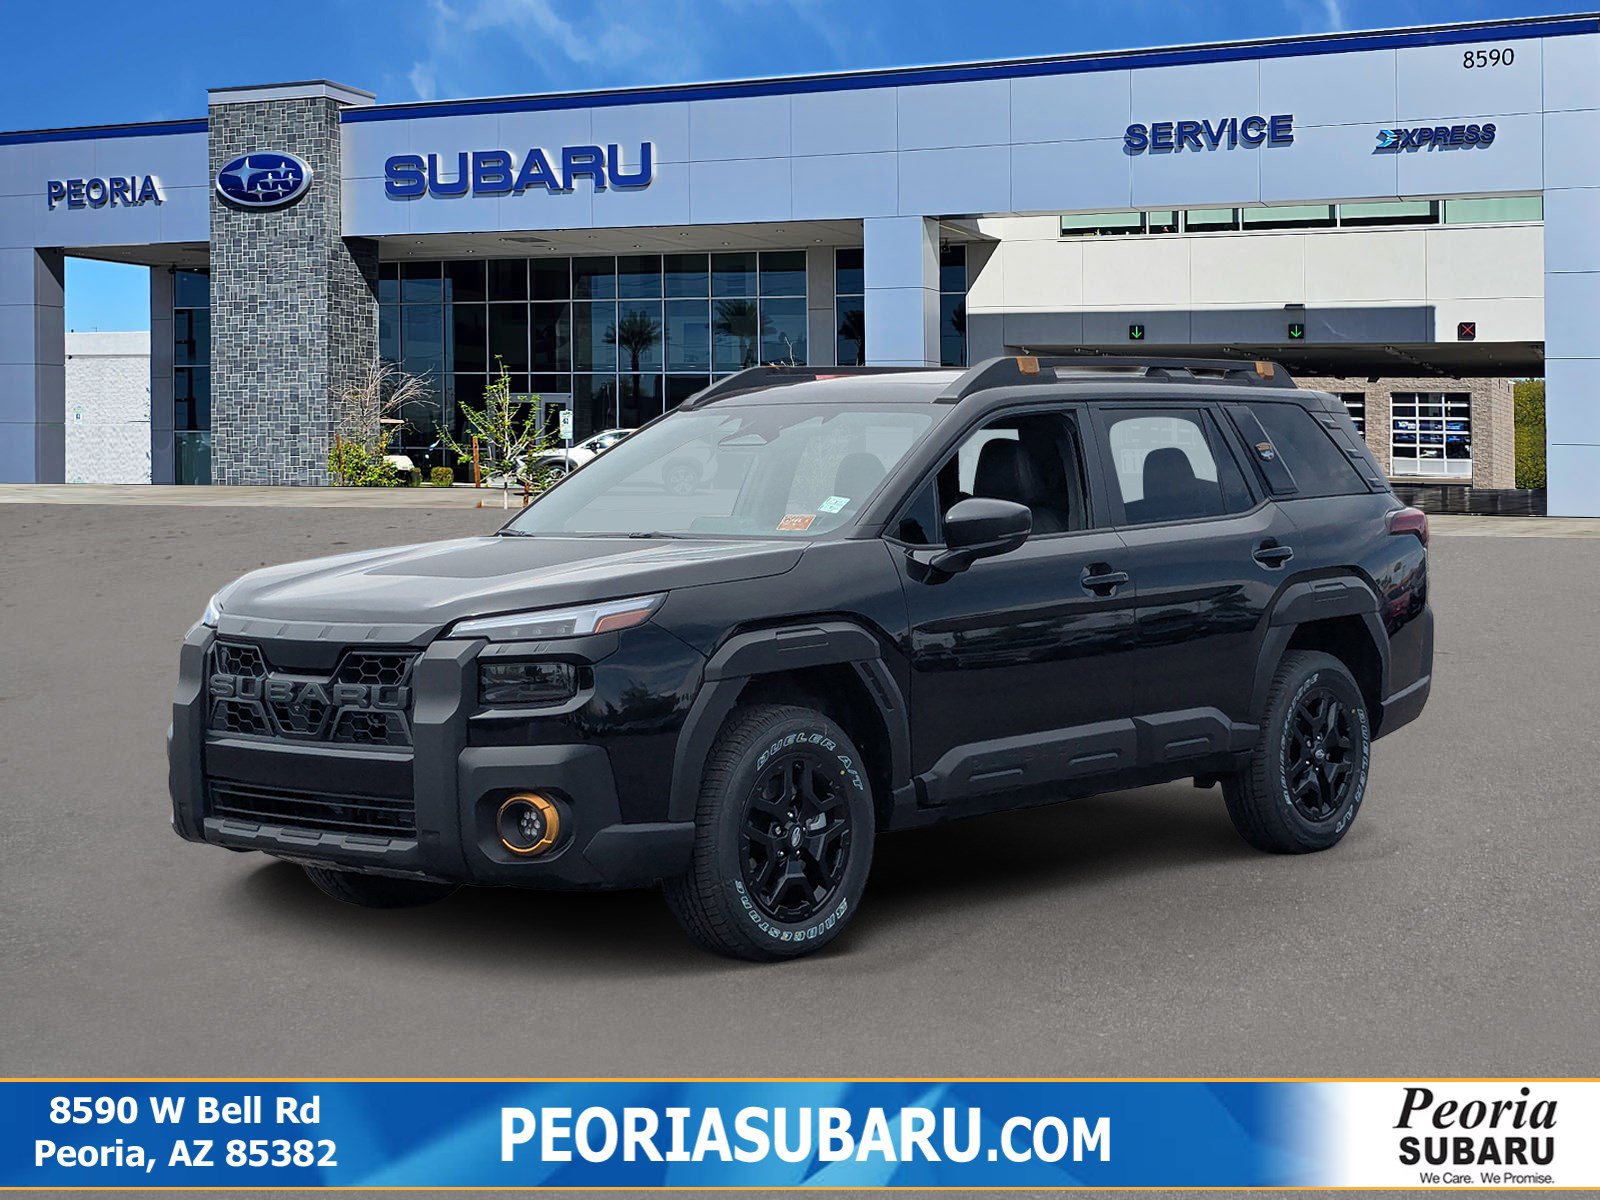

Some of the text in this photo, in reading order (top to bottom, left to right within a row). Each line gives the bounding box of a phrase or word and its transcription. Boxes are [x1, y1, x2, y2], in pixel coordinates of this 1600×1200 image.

[1463, 48, 1514, 69] 8590
[1125, 114, 1294, 151] SERVICE
[1375, 123, 1497, 148] EXPRESS
[384, 142, 653, 197] SUBARU
[47, 175, 163, 209] PEORIA
[209, 673, 414, 710] SUBARU
[756, 732, 837, 772] DUELER
[734, 880, 849, 942] BRIDGESTONE
